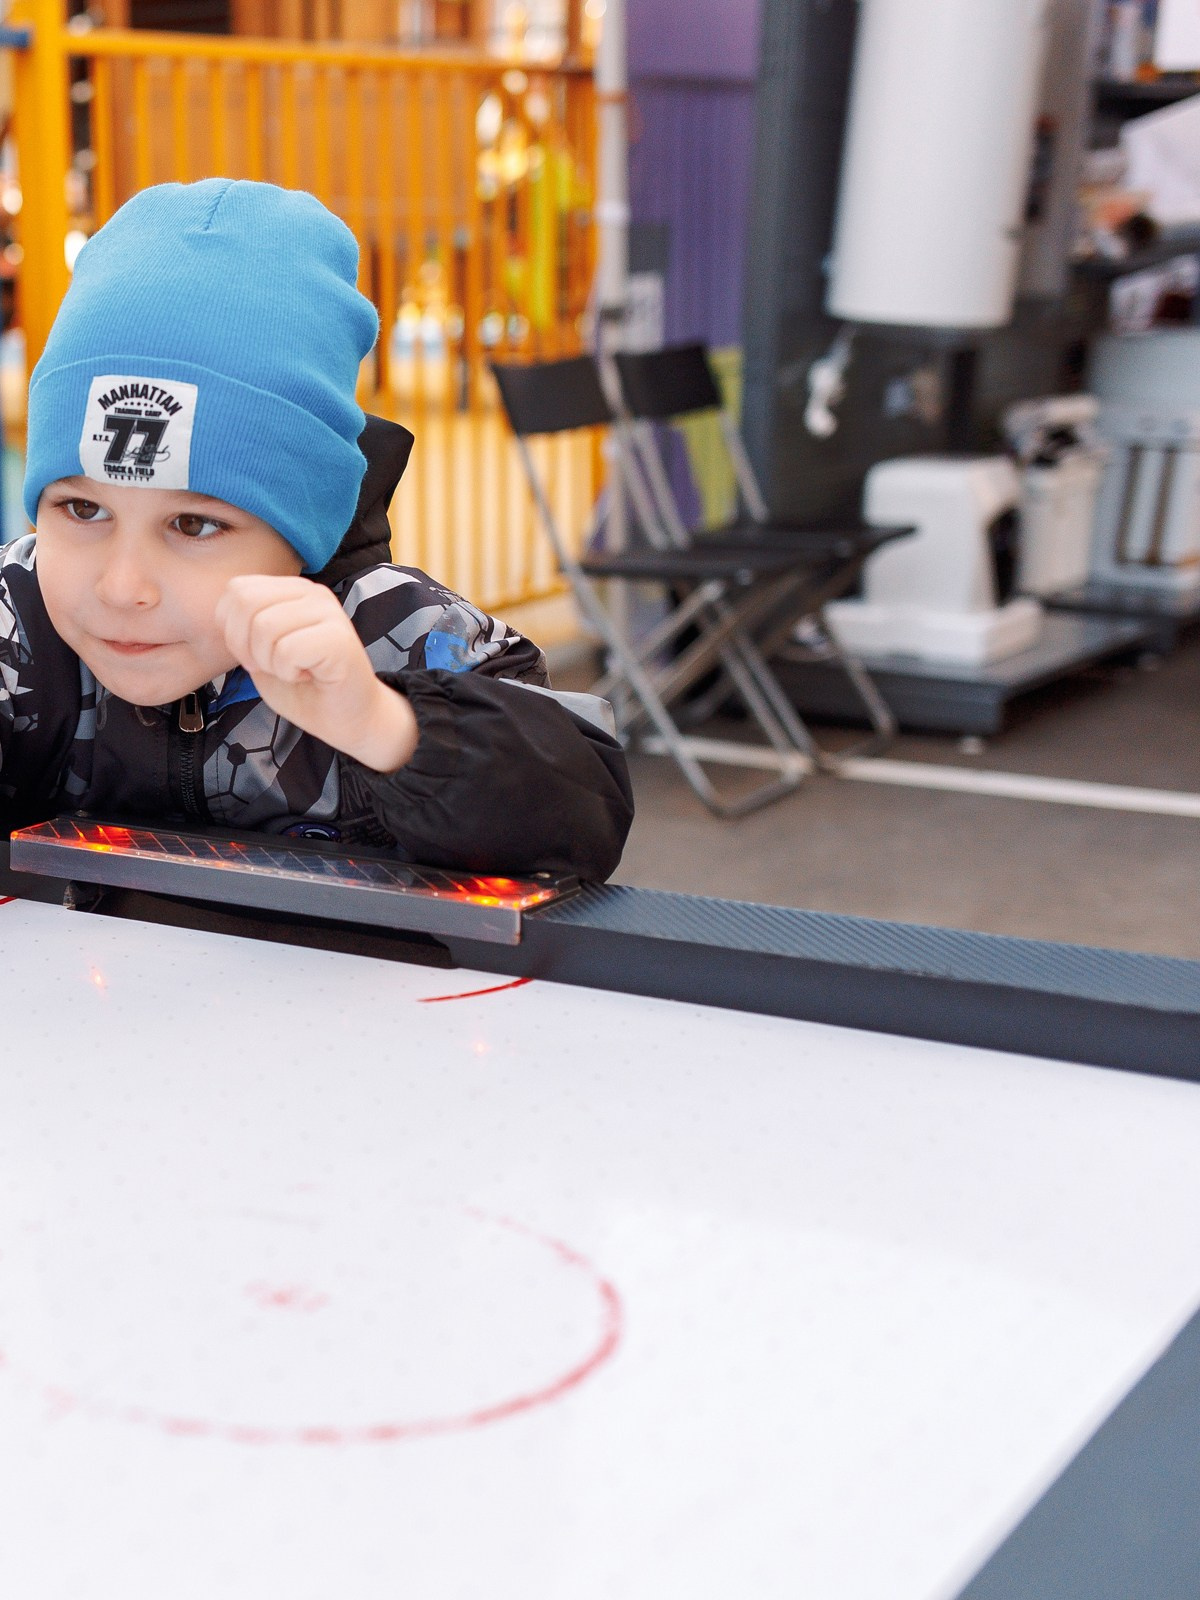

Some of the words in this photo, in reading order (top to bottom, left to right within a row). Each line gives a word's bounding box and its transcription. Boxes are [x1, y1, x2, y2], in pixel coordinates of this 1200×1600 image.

[97, 383, 183, 416] MANHATTAN
[103, 414, 170, 467] 77
[103, 464, 127, 474] TRACK
[128, 466, 134, 475] &
[135, 467, 155, 477] FIELD
